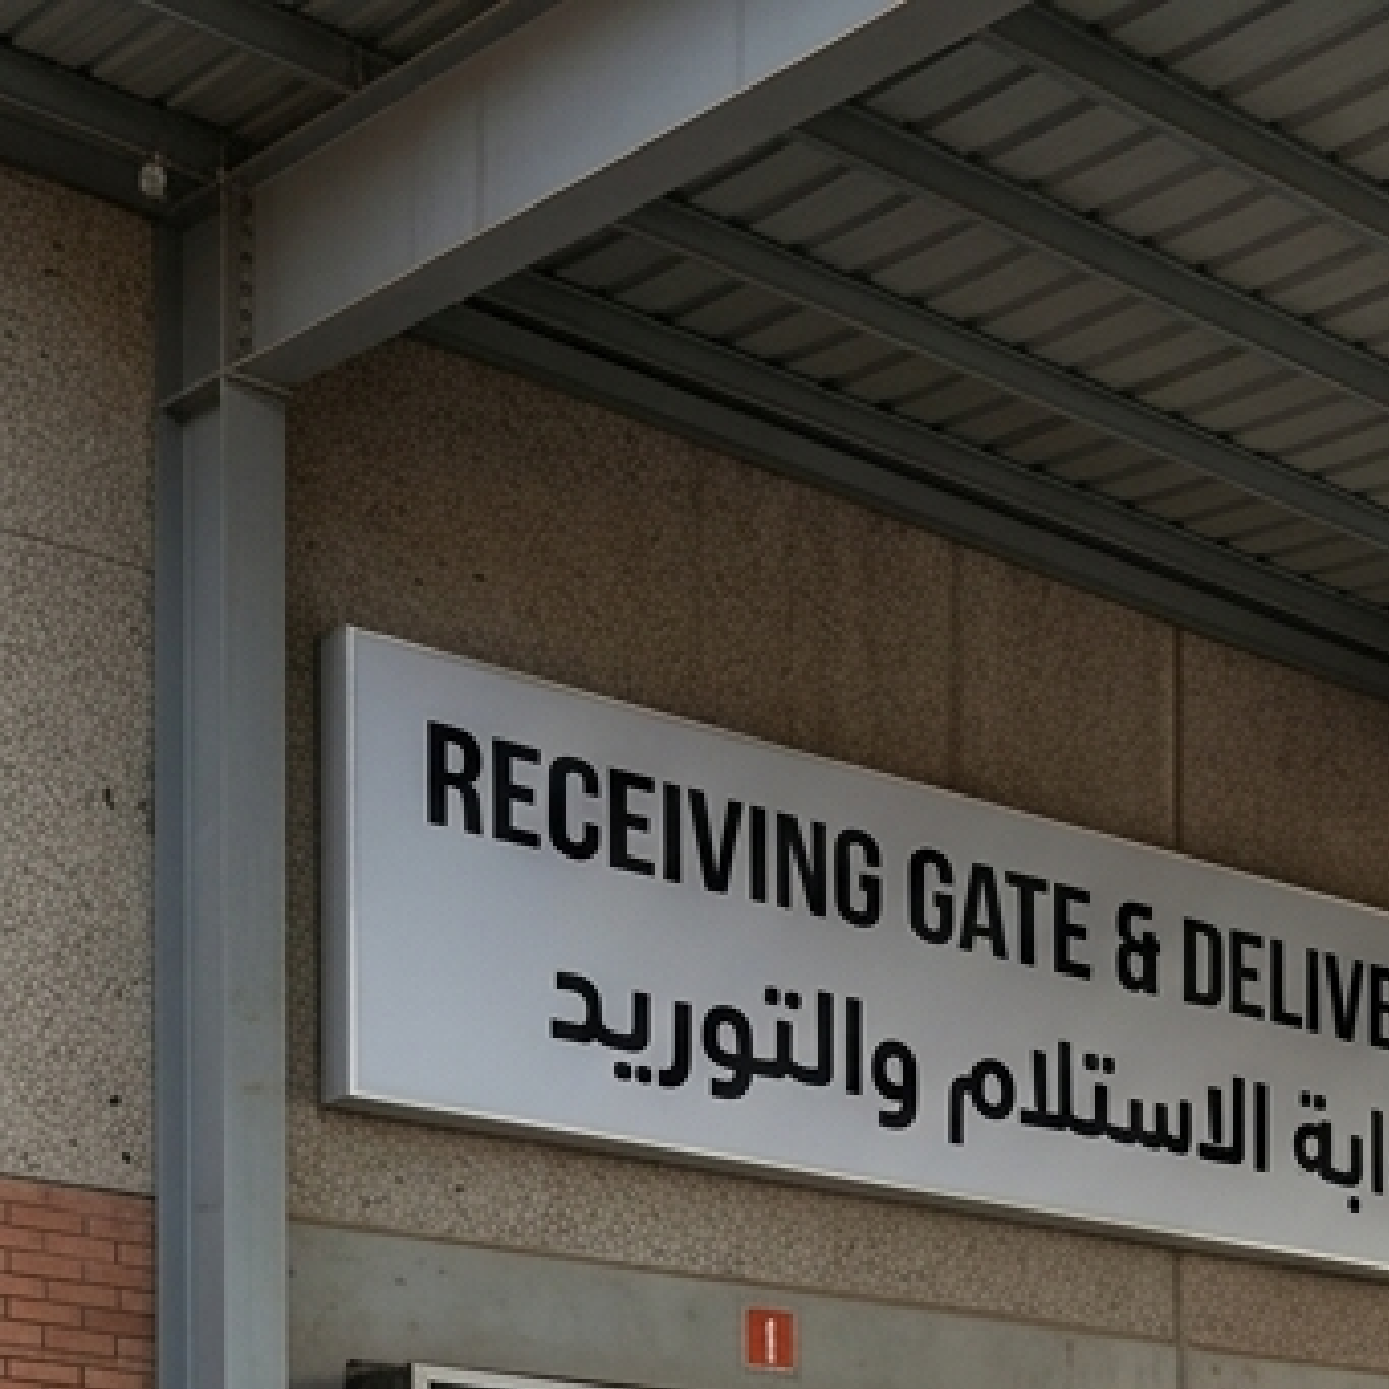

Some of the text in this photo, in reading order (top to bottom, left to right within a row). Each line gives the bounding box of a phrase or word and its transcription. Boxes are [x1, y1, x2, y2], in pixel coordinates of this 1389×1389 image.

[427, 720, 883, 928] RECEIVING
[907, 846, 1090, 981] GATE
[1115, 903, 1160, 993] &
[549, 972, 916, 1131] والتوريد
[948, 1042, 1270, 1172] الاستلام
